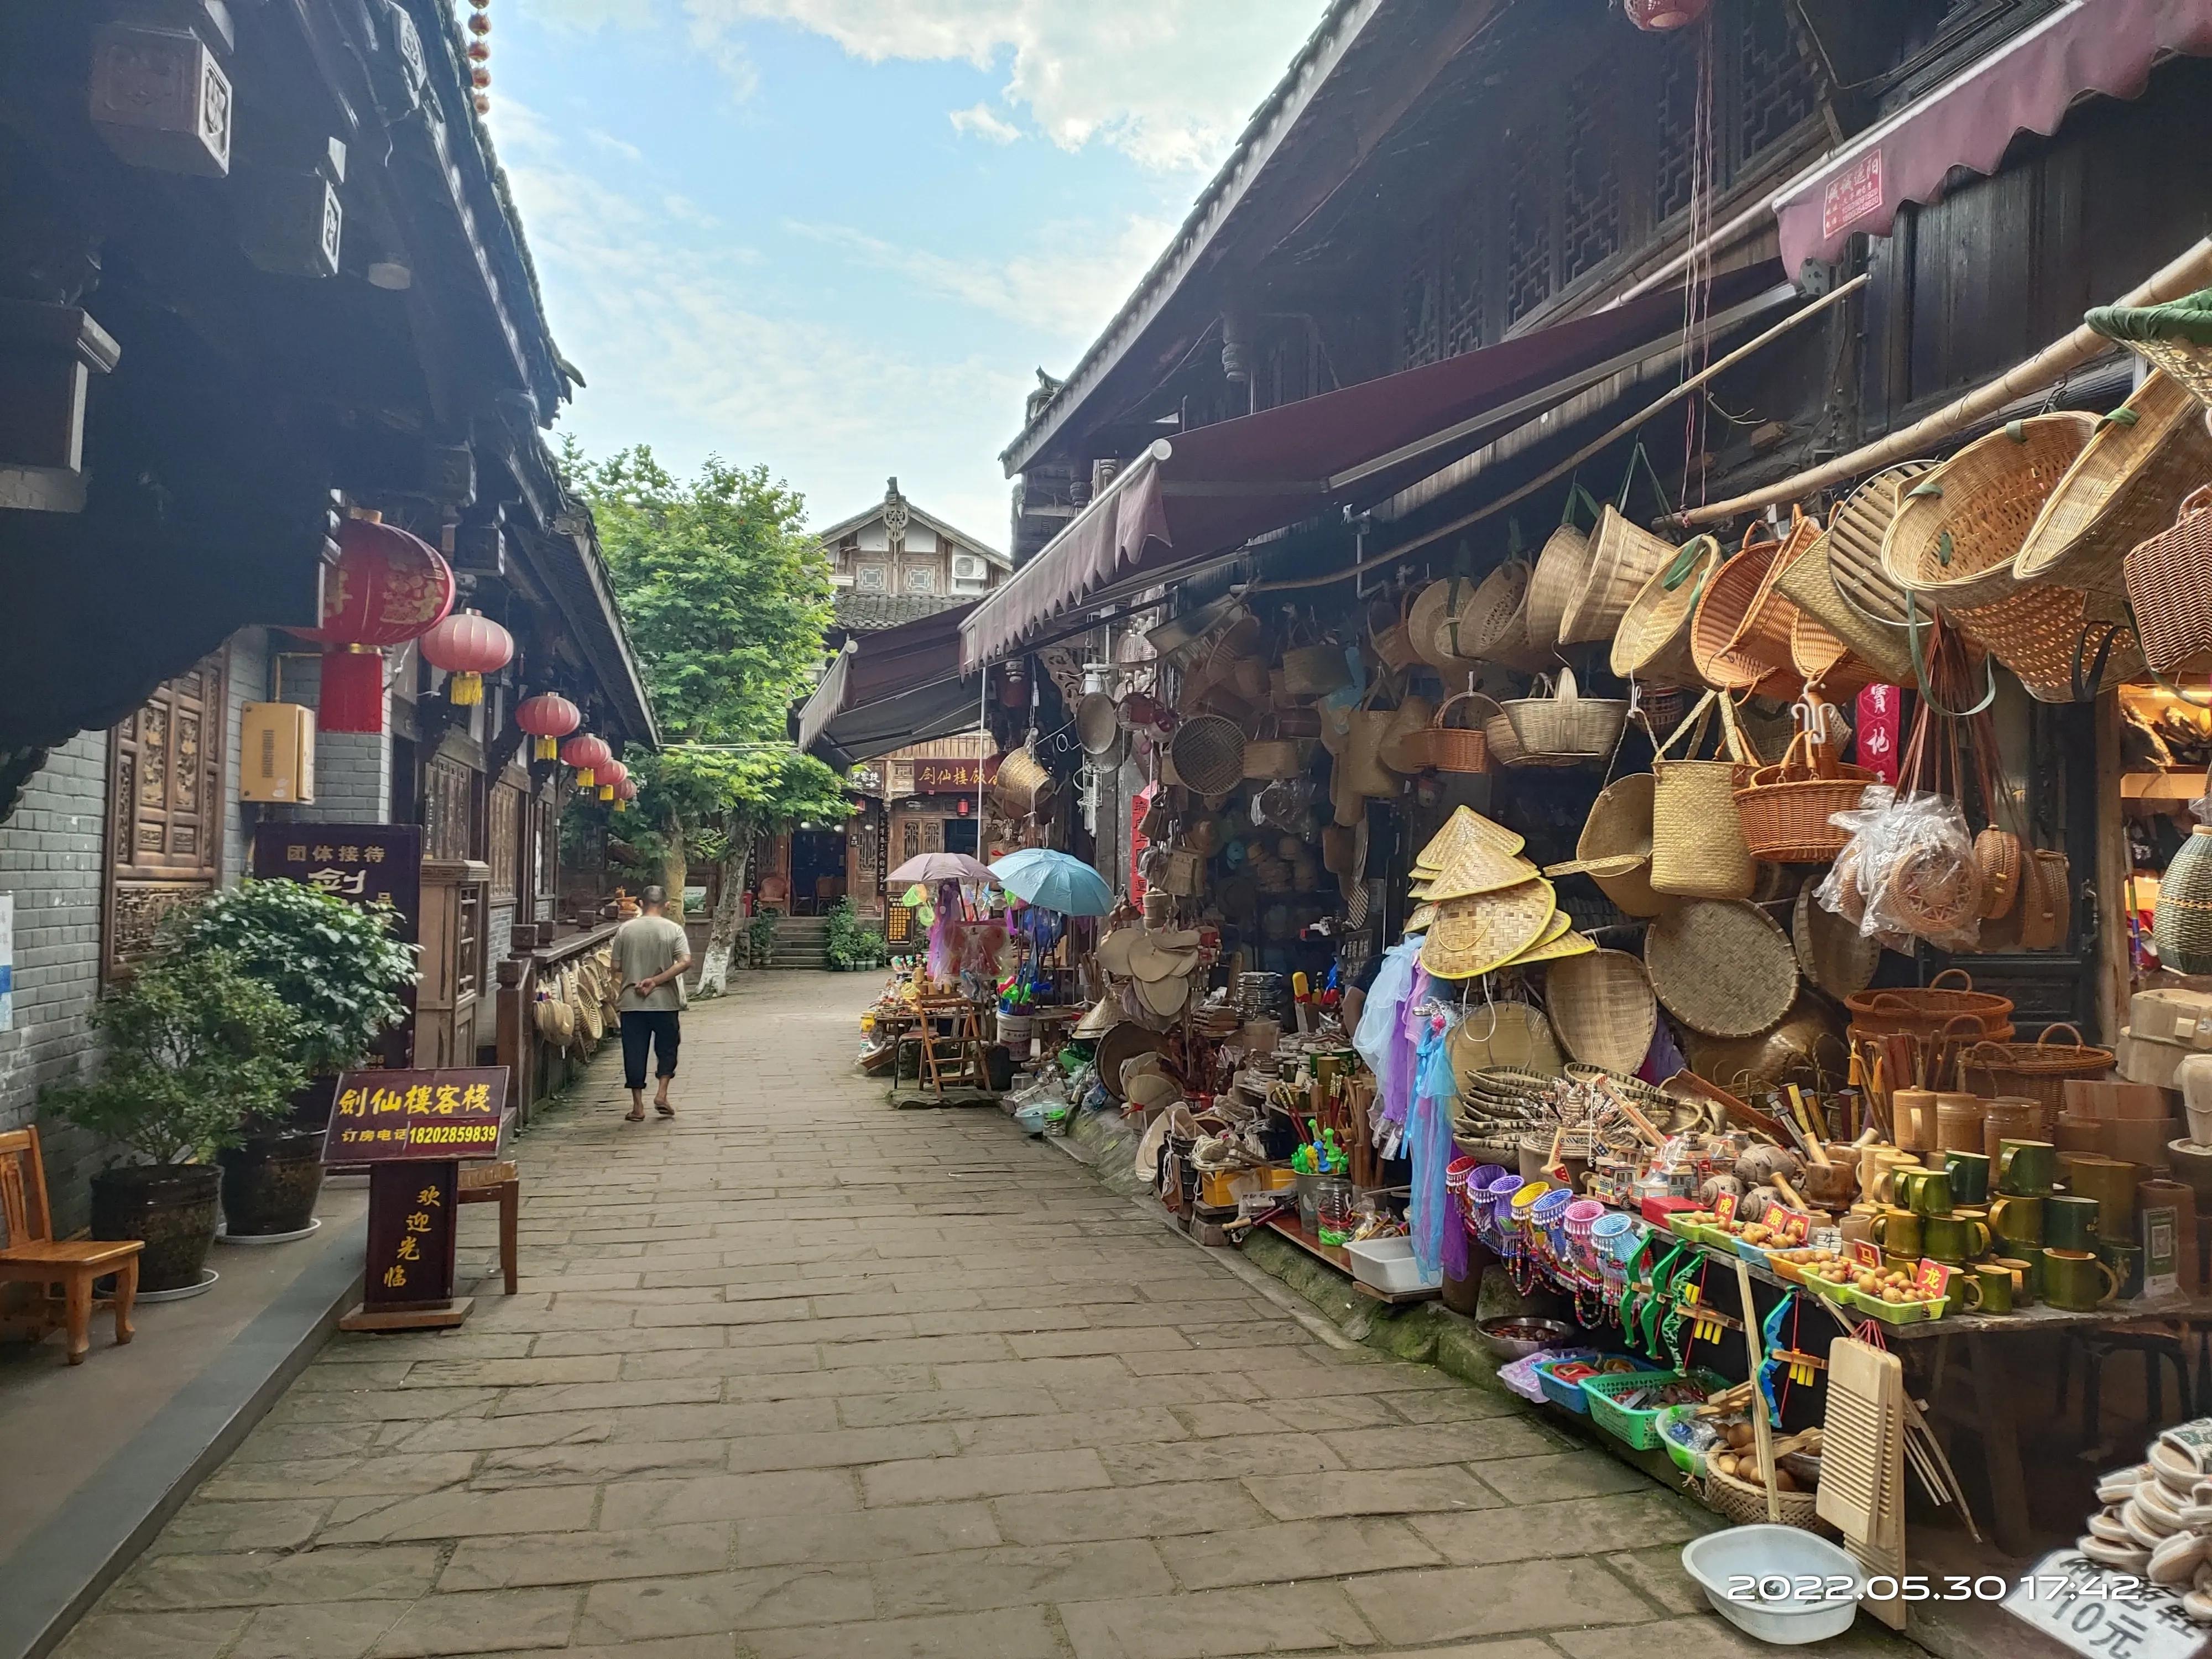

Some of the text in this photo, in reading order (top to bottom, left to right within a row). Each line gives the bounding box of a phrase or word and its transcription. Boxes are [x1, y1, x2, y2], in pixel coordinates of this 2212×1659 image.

[409, 1125, 497, 1144] 18202859839
[1718, 1197, 1732, 1220] 虎
[384, 1185, 440, 1288] 欢迎光临
